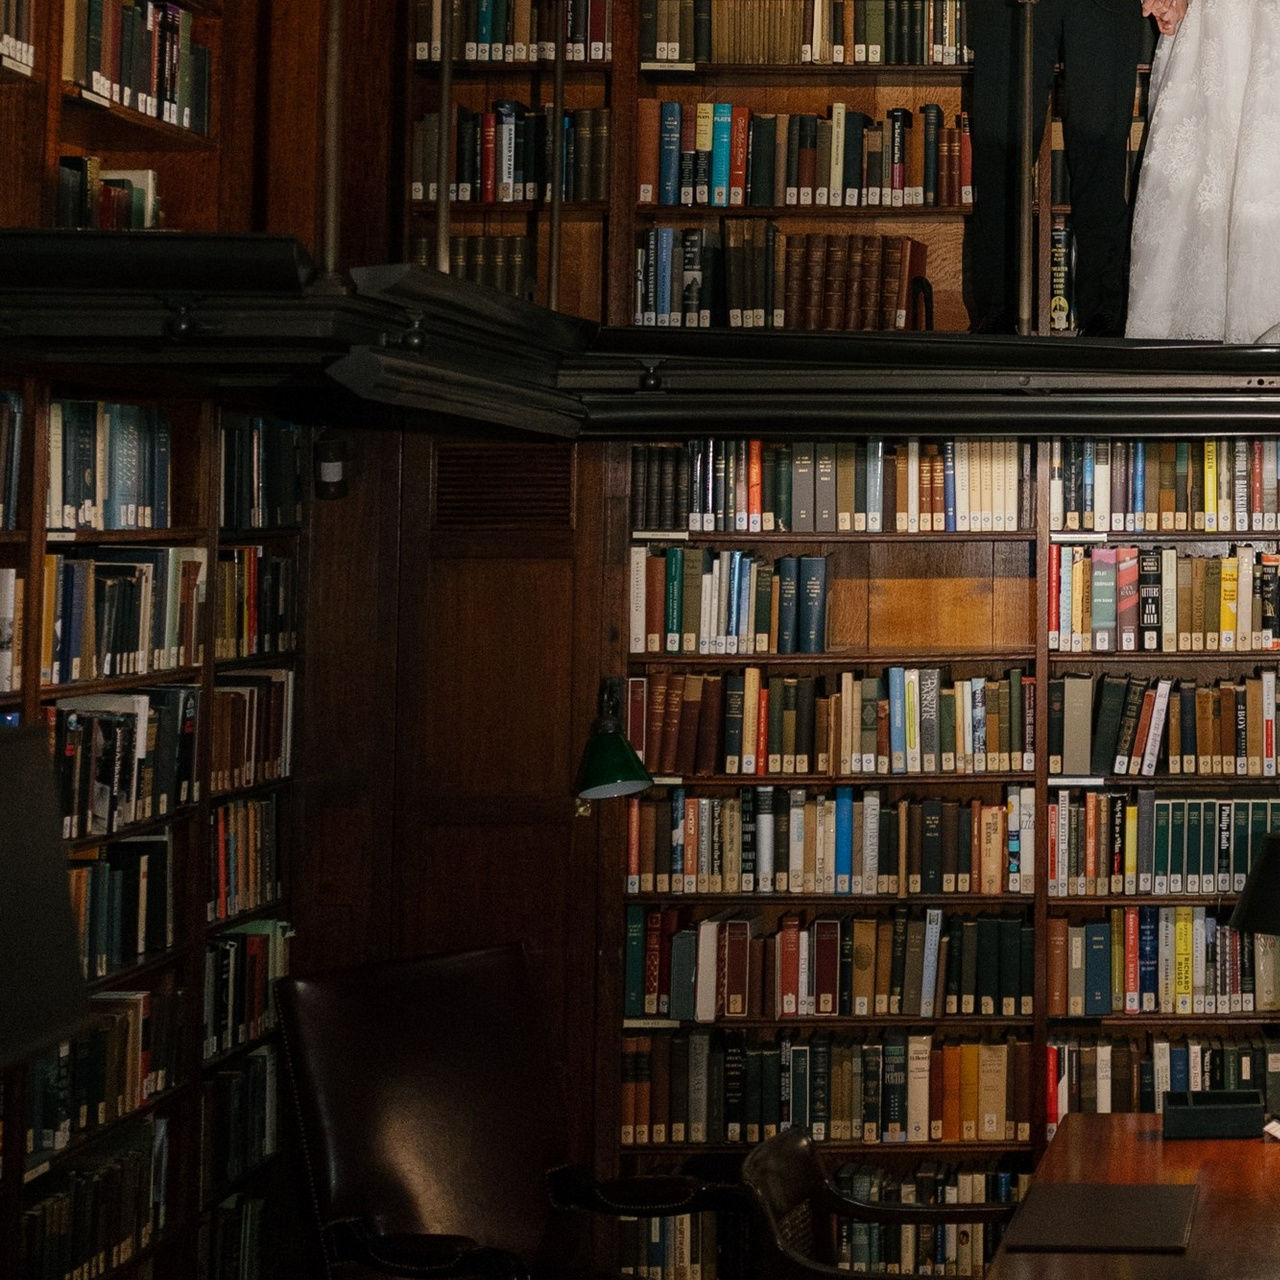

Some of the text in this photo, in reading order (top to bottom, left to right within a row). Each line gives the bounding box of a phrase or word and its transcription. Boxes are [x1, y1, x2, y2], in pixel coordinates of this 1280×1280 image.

[1141, 587, 1160, 598] LETTERS
[1145, 603, 1156, 614] AYN
[1143, 613, 1158, 625] RAND
[921, 680, 930, 721] PARKER
[1220, 805, 1230, 850] Philip Roth
